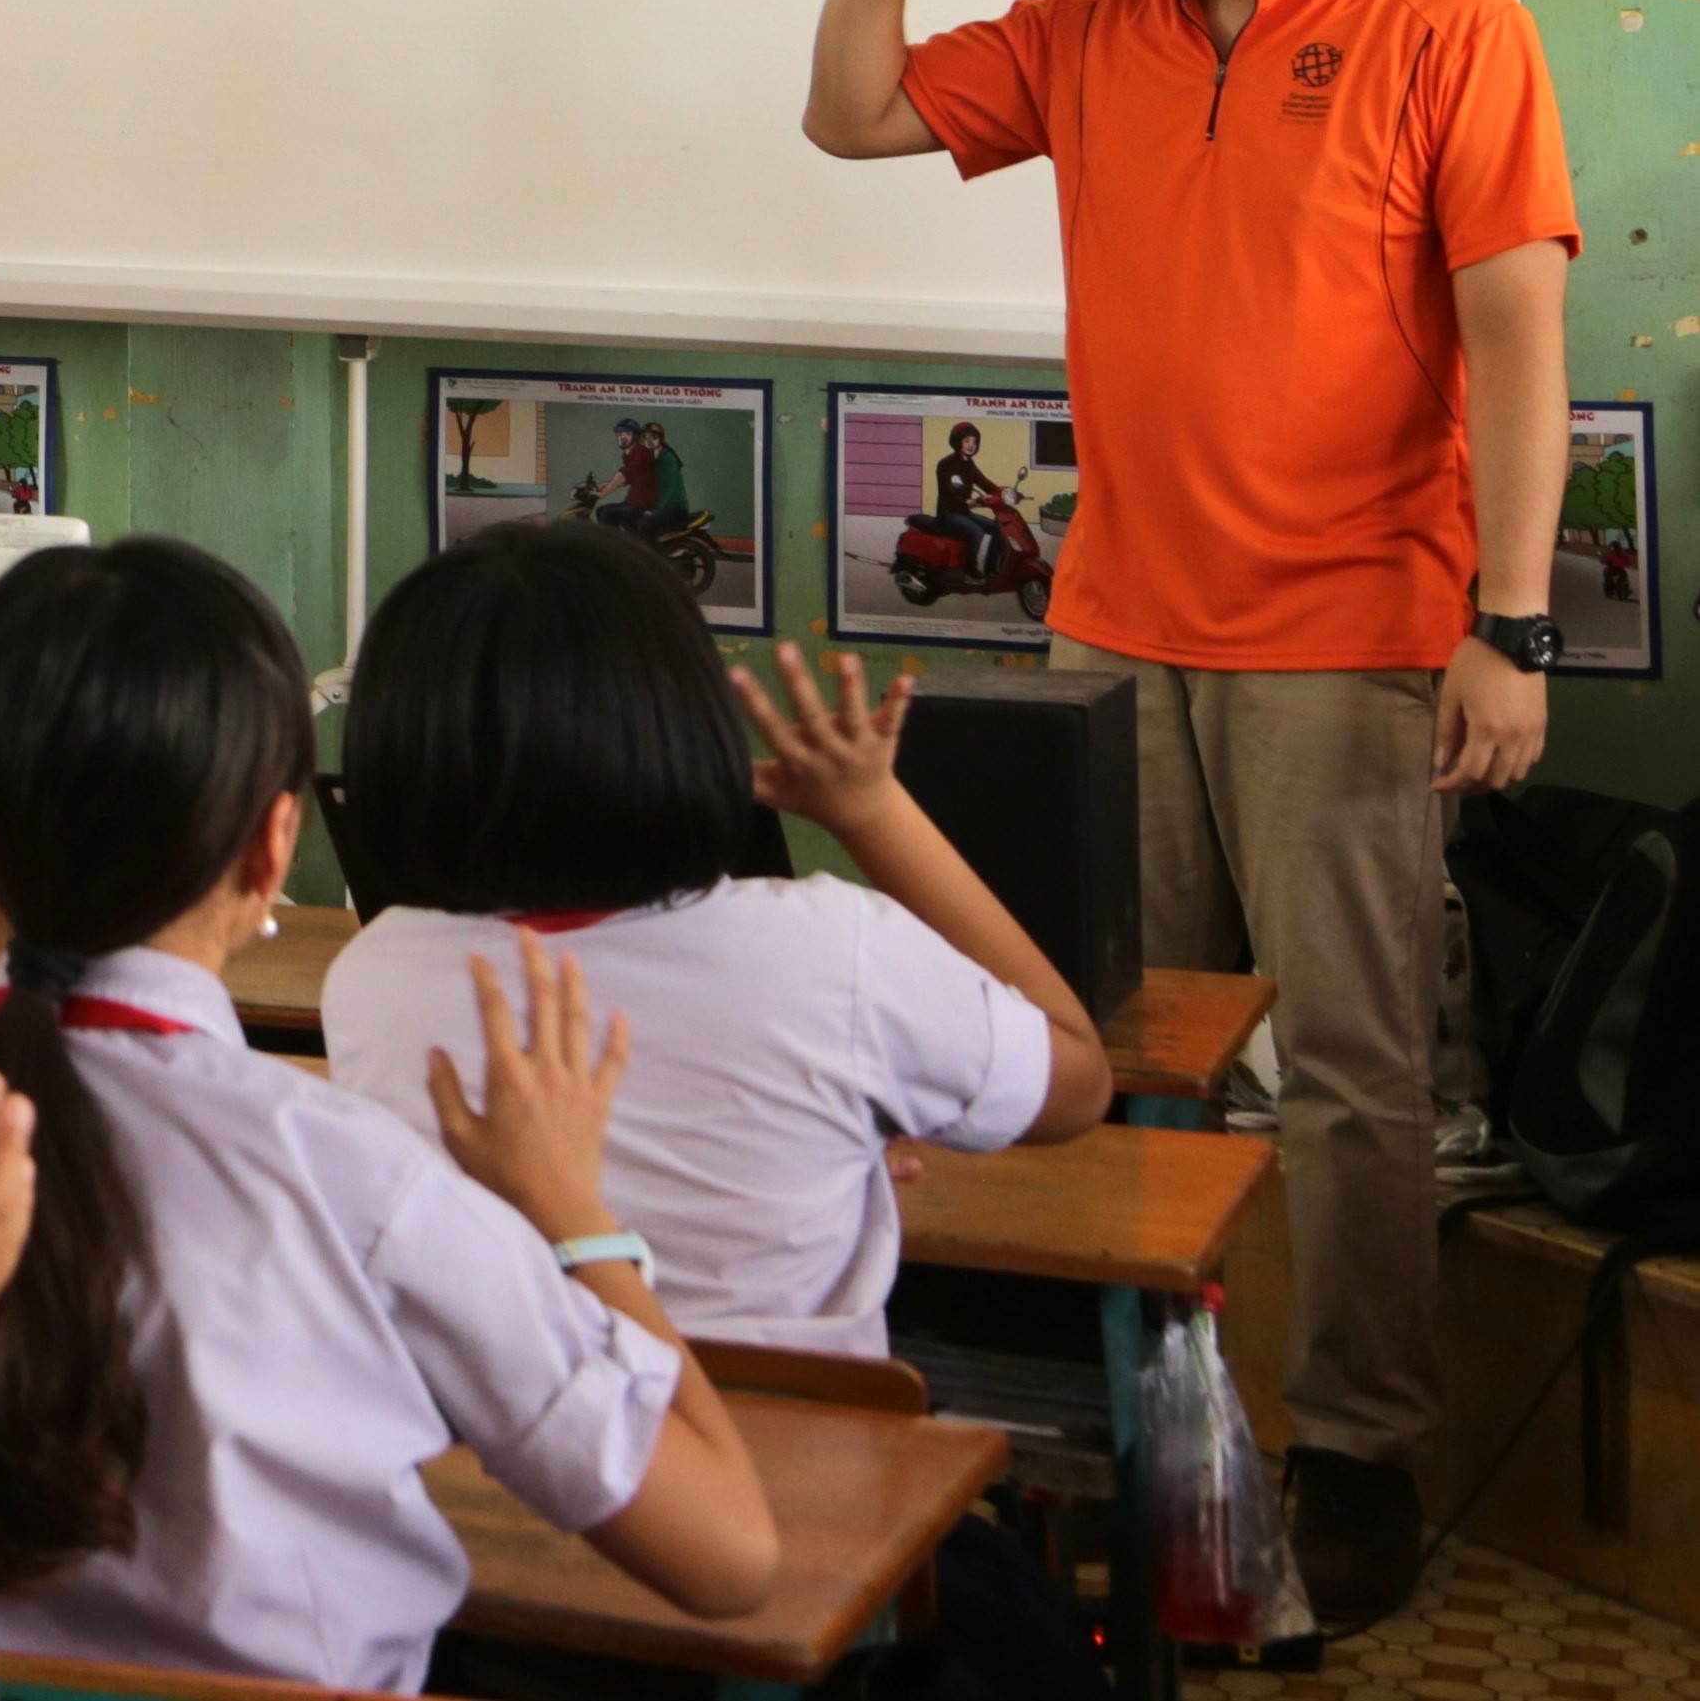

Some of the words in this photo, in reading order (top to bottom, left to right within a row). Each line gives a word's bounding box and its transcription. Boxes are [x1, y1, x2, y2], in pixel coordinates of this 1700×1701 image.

[558, 382, 596, 393] TRANH
[600, 383, 616, 394] AN
[653, 386, 681, 397] GIAO
[965, 397, 1007, 408] TRANH
[1010, 400, 1027, 409] AN
